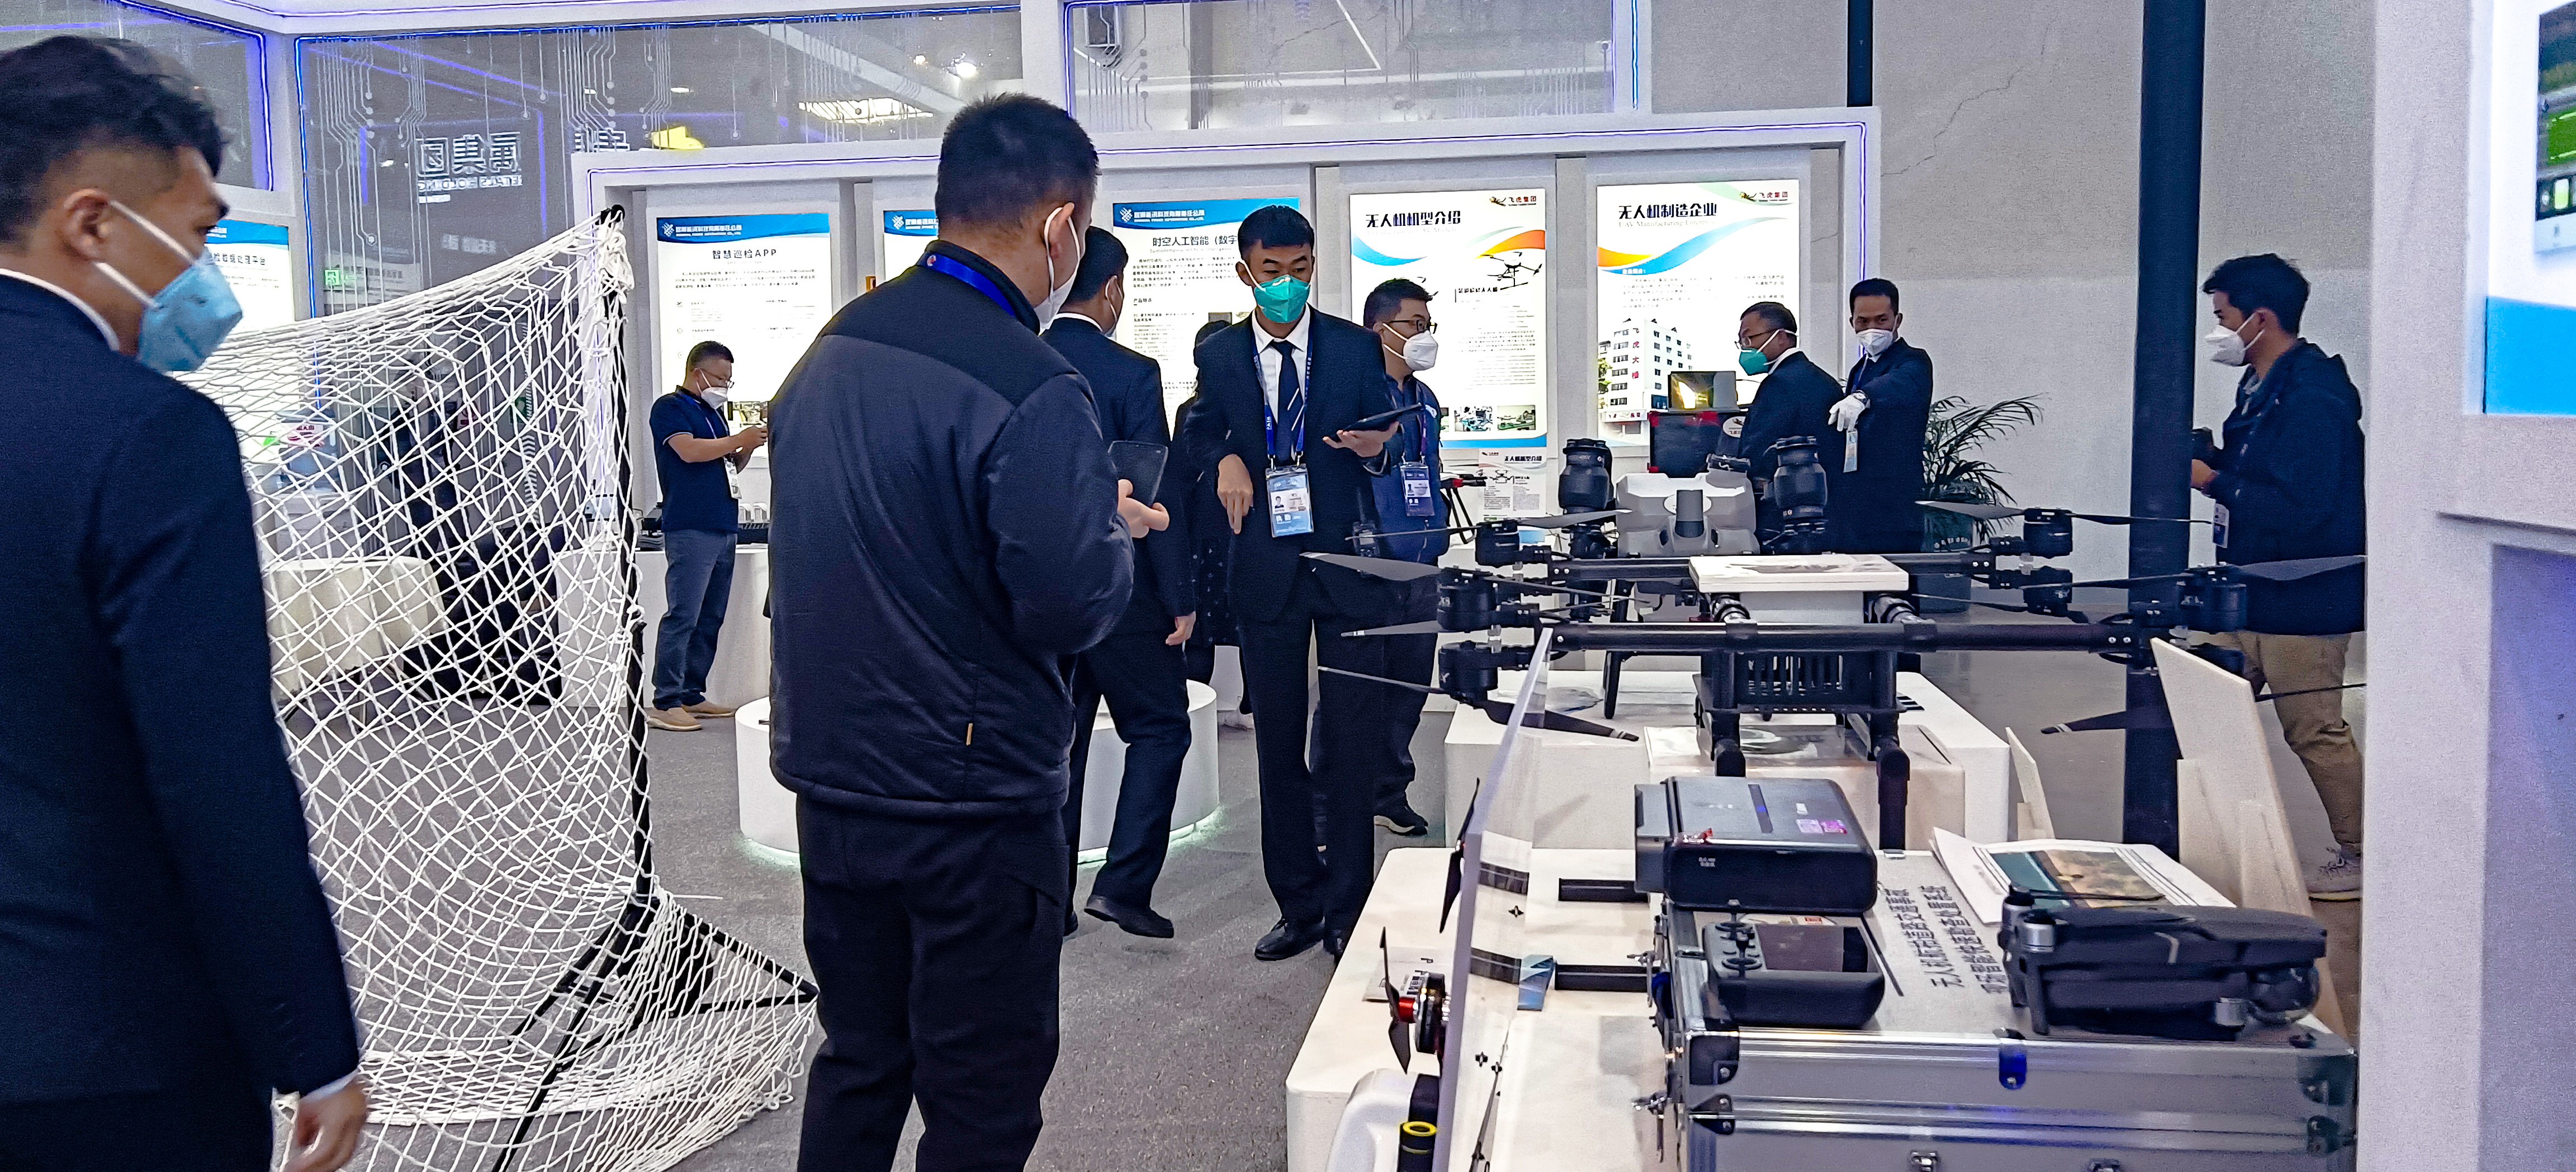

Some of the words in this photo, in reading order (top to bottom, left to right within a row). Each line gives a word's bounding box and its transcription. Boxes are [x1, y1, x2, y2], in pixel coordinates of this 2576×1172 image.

[1619, 202, 1717, 219] 无人机制造企业
[1366, 211, 1461, 228] 无人机机型介绍
[713, 249, 776, 259] 智慧巡检APP
